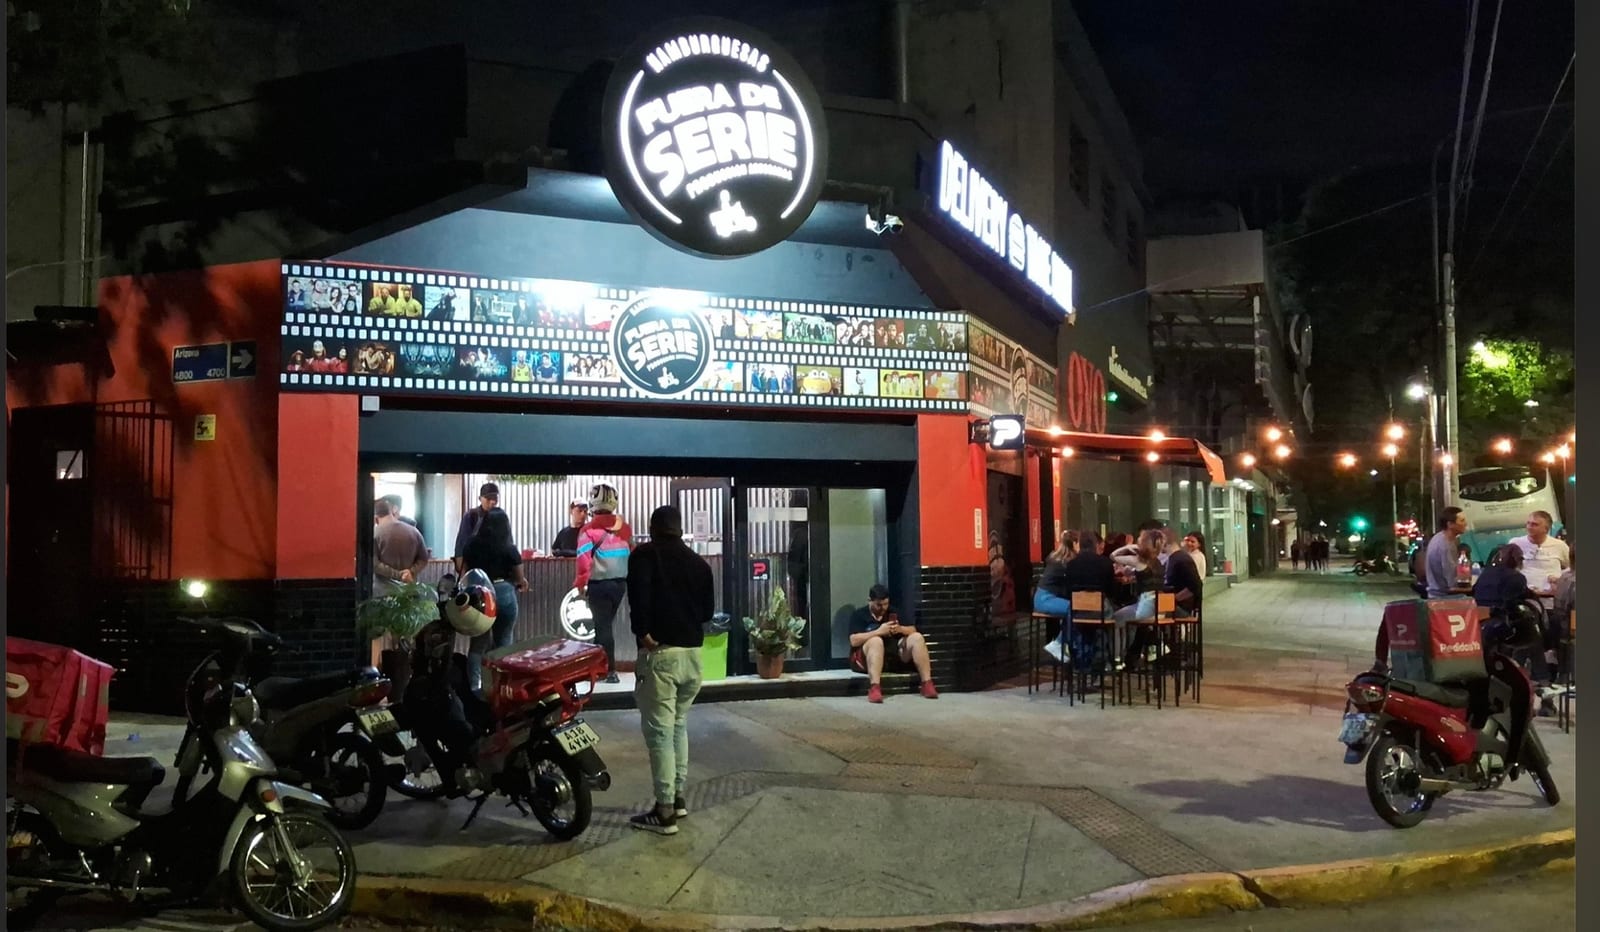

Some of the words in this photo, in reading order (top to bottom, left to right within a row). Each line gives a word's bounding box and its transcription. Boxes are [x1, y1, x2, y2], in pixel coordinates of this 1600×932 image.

[635, 83, 736, 136] FUERA
[738, 82, 783, 110] DE
[643, 110, 798, 197] SERIE
[939, 140, 1009, 258] DELIVERY
[206, 367, 226, 378] 4700
[627, 330, 699, 372] SERIE
